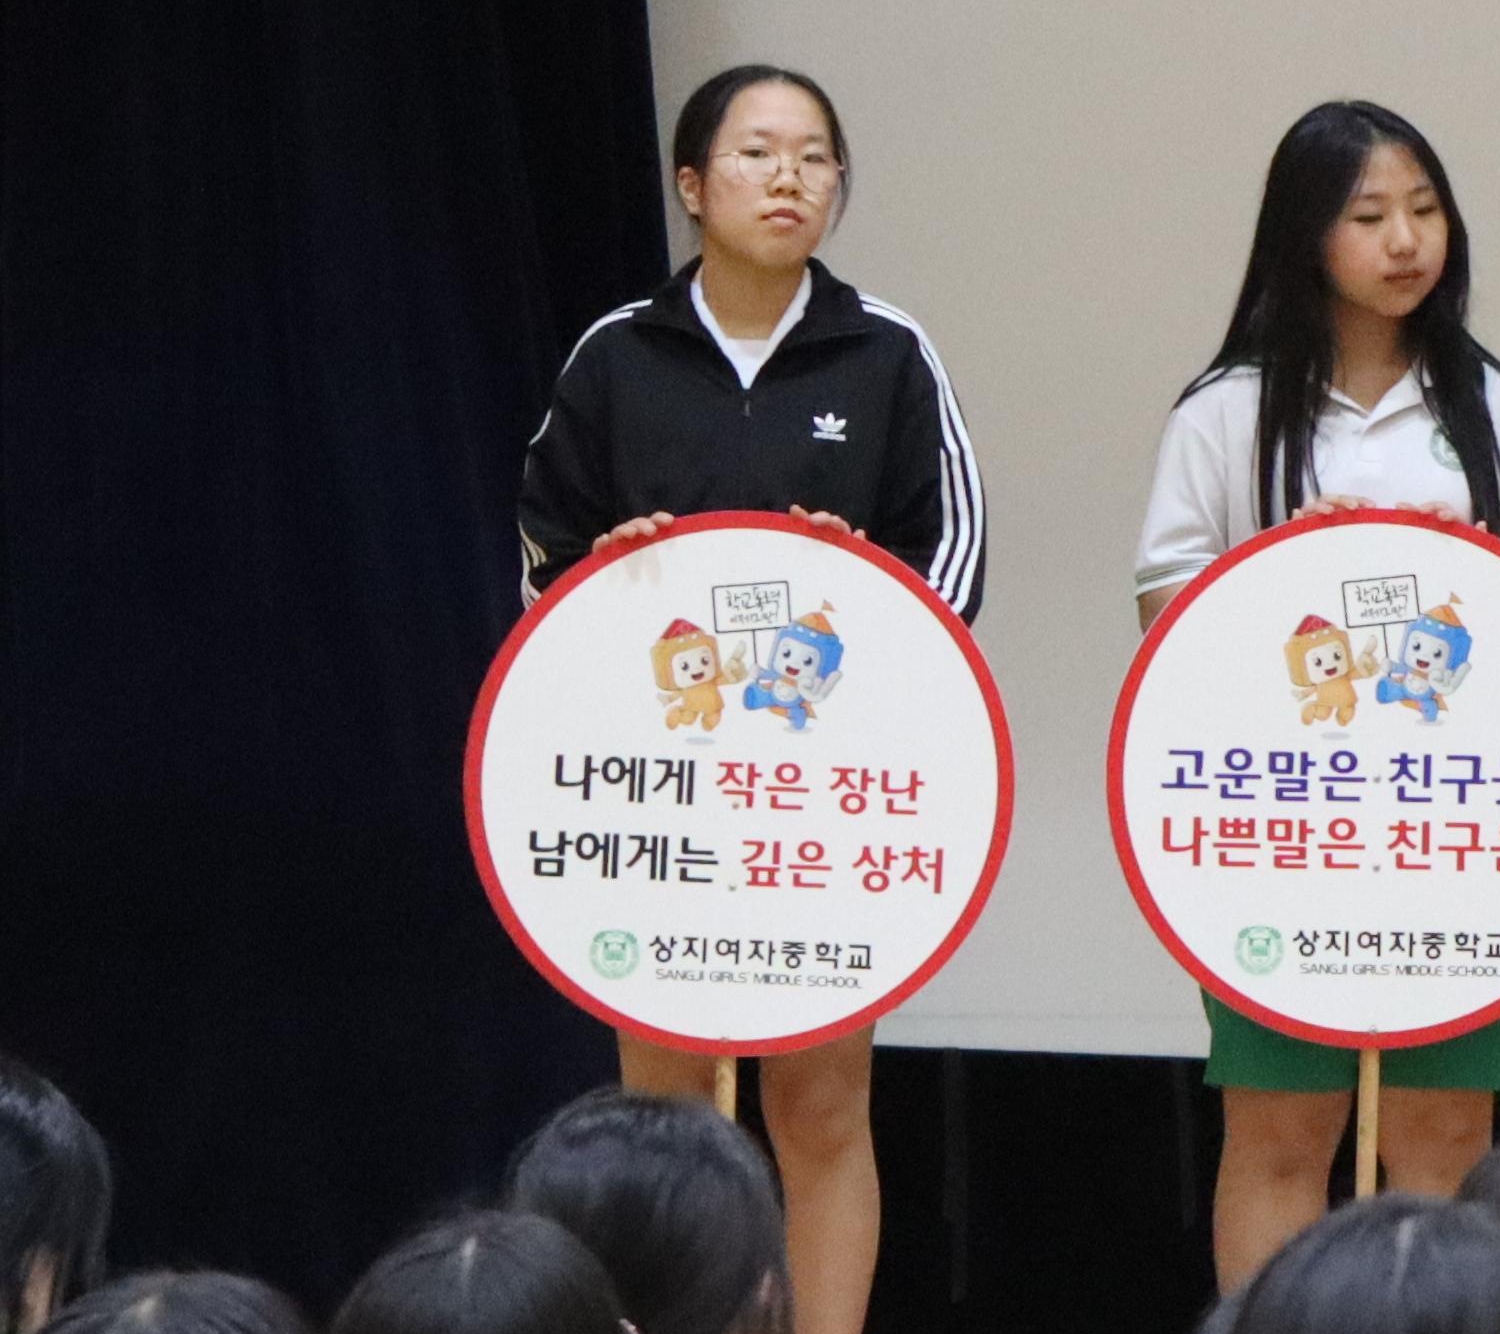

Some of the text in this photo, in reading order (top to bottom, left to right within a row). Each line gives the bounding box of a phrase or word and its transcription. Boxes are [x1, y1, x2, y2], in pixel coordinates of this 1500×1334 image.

[555, 755, 924, 815] 나에게 작은 장난
[1161, 749, 1367, 802] 고운말은
[529, 830, 945, 893] 남에게는 깊은 상처
[1161, 817, 1365, 870] 나쁜말은
[649, 935, 872, 969] 상지여자중학교
[1300, 963, 1347, 975] SANGJI
[1396, 965, 1442, 976] MIDDLE
[656, 969, 704, 982] SANGJI
[754, 973, 802, 986] MIDDLE
[807, 975, 862, 989] SCHOOL
